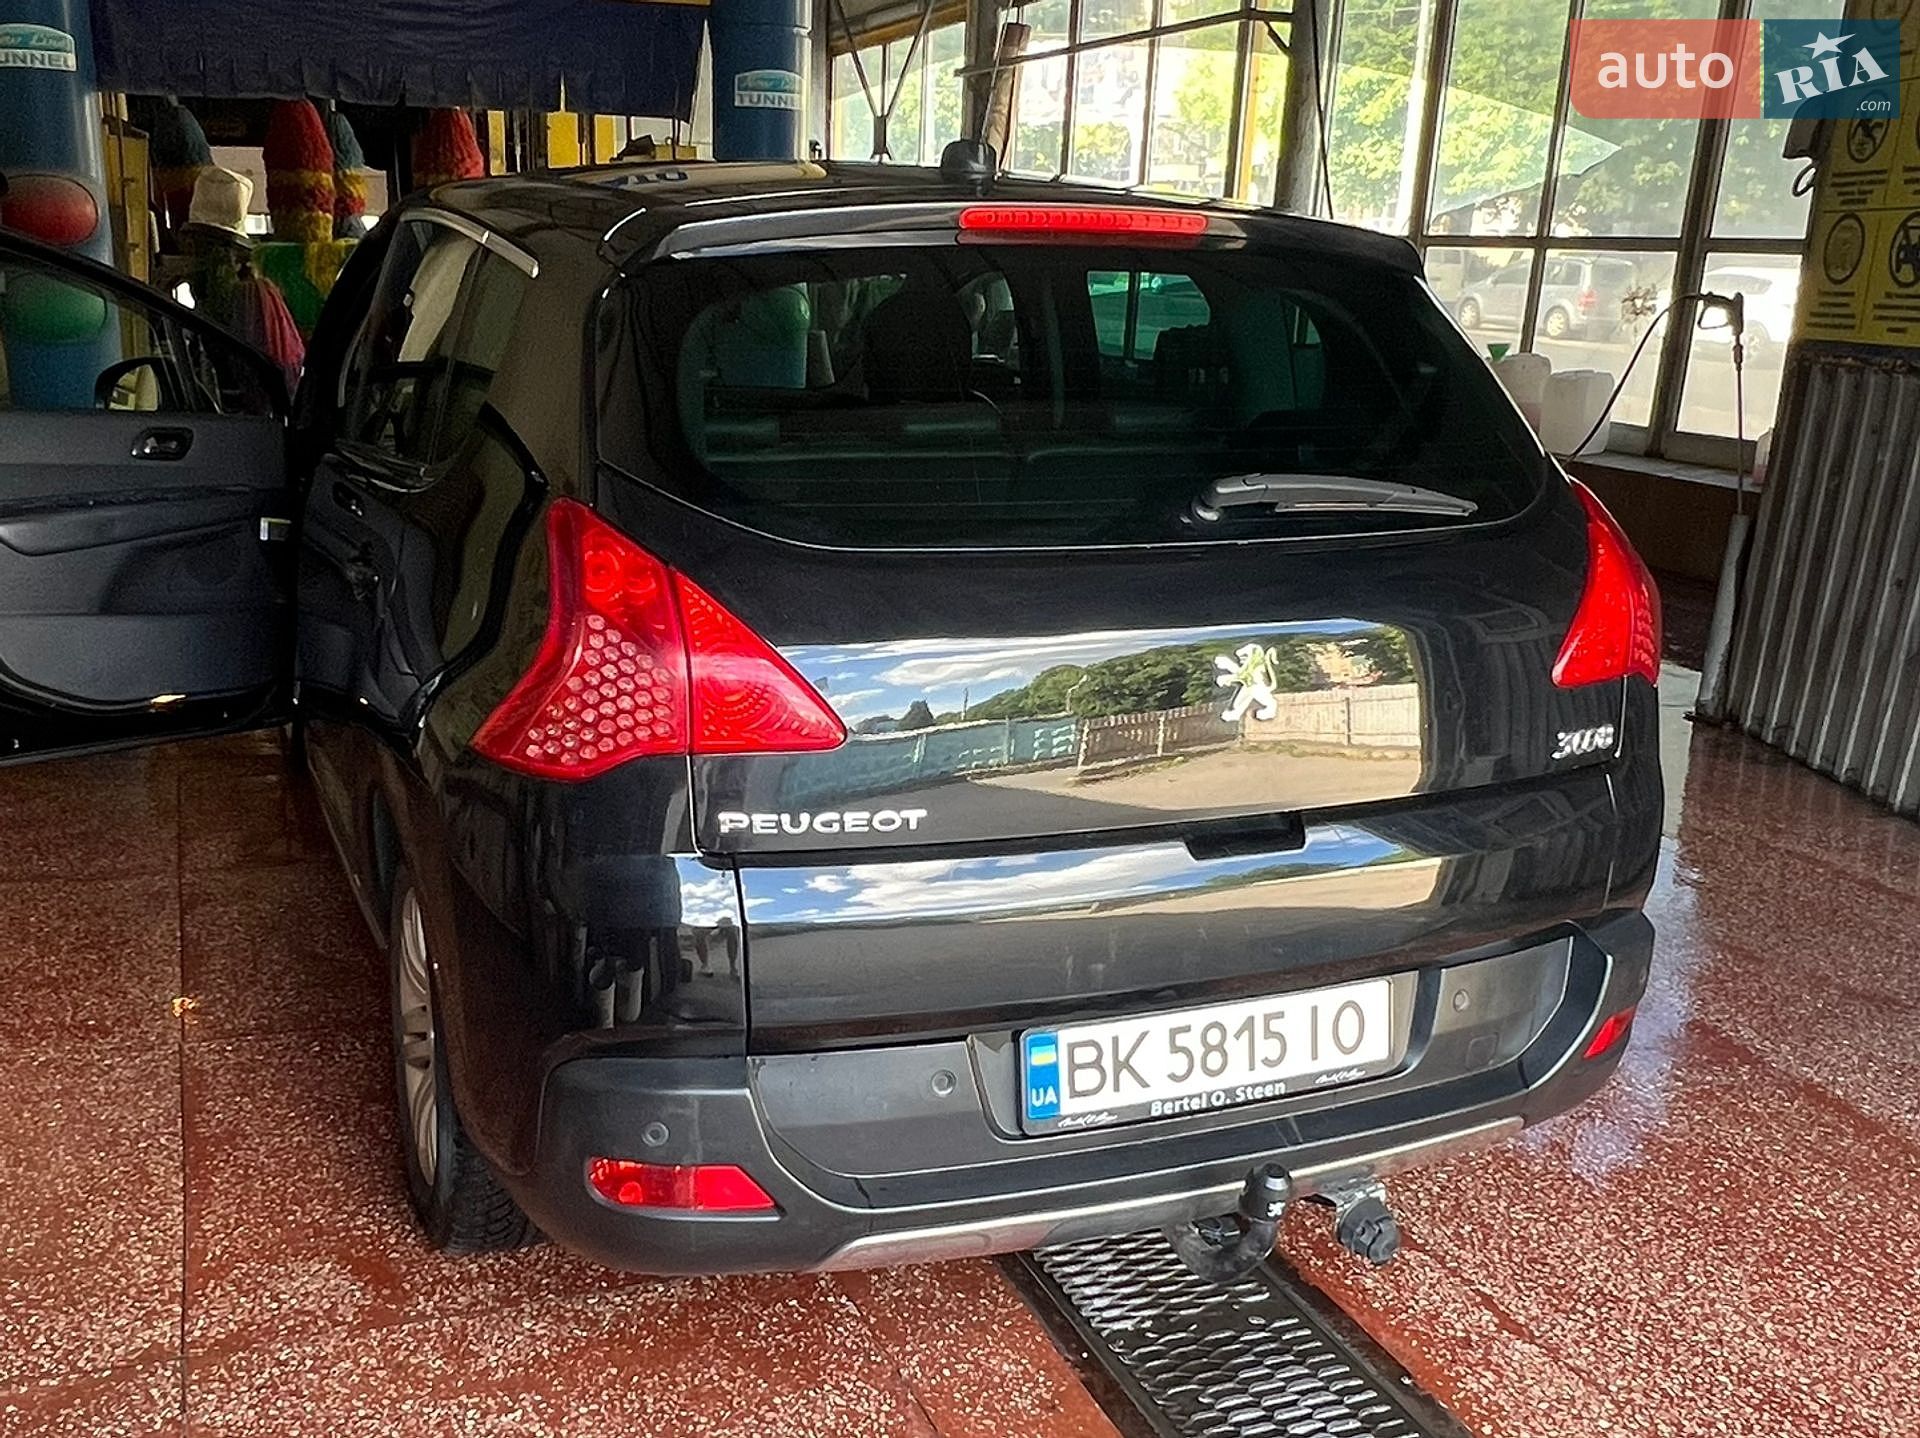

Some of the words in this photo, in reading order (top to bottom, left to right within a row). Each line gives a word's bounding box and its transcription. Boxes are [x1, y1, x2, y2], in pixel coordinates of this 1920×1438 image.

[717, 808, 928, 835] PEUGEOT
[1067, 1029, 1151, 1100] BK
[1167, 1010, 1288, 1083] 5815
[1311, 1000, 1365, 1061] IO
[1031, 1086, 1058, 1107] UA
[1150, 1092, 1207, 1116] Bertel
[1210, 1091, 1231, 1106] O.
[1235, 1081, 1286, 1101] Steen
